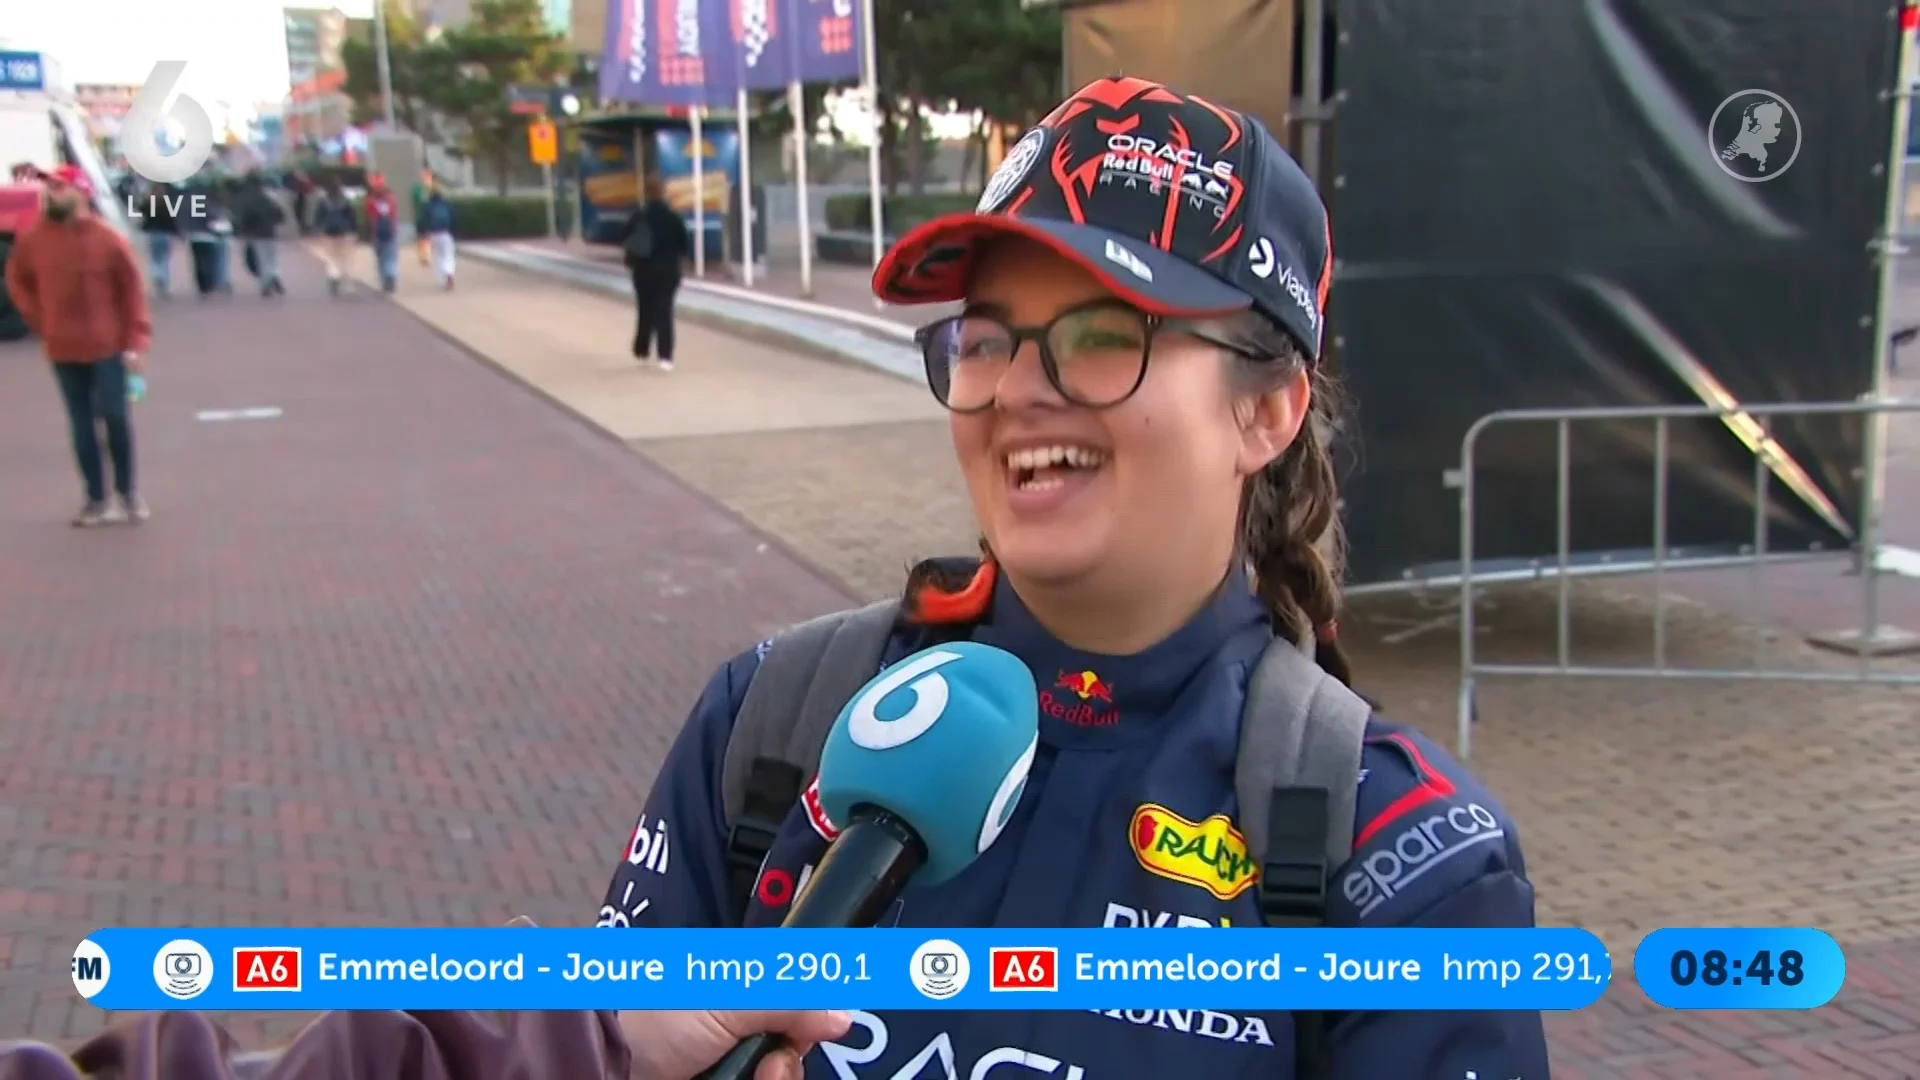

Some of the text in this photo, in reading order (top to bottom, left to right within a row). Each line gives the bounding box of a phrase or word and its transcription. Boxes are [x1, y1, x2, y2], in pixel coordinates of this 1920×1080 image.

[1107, 134, 1233, 182] ORACLE
[848, 651, 964, 750] 6
[622, 812, 668, 875] bil
[1343, 803, 1497, 907] sparco
